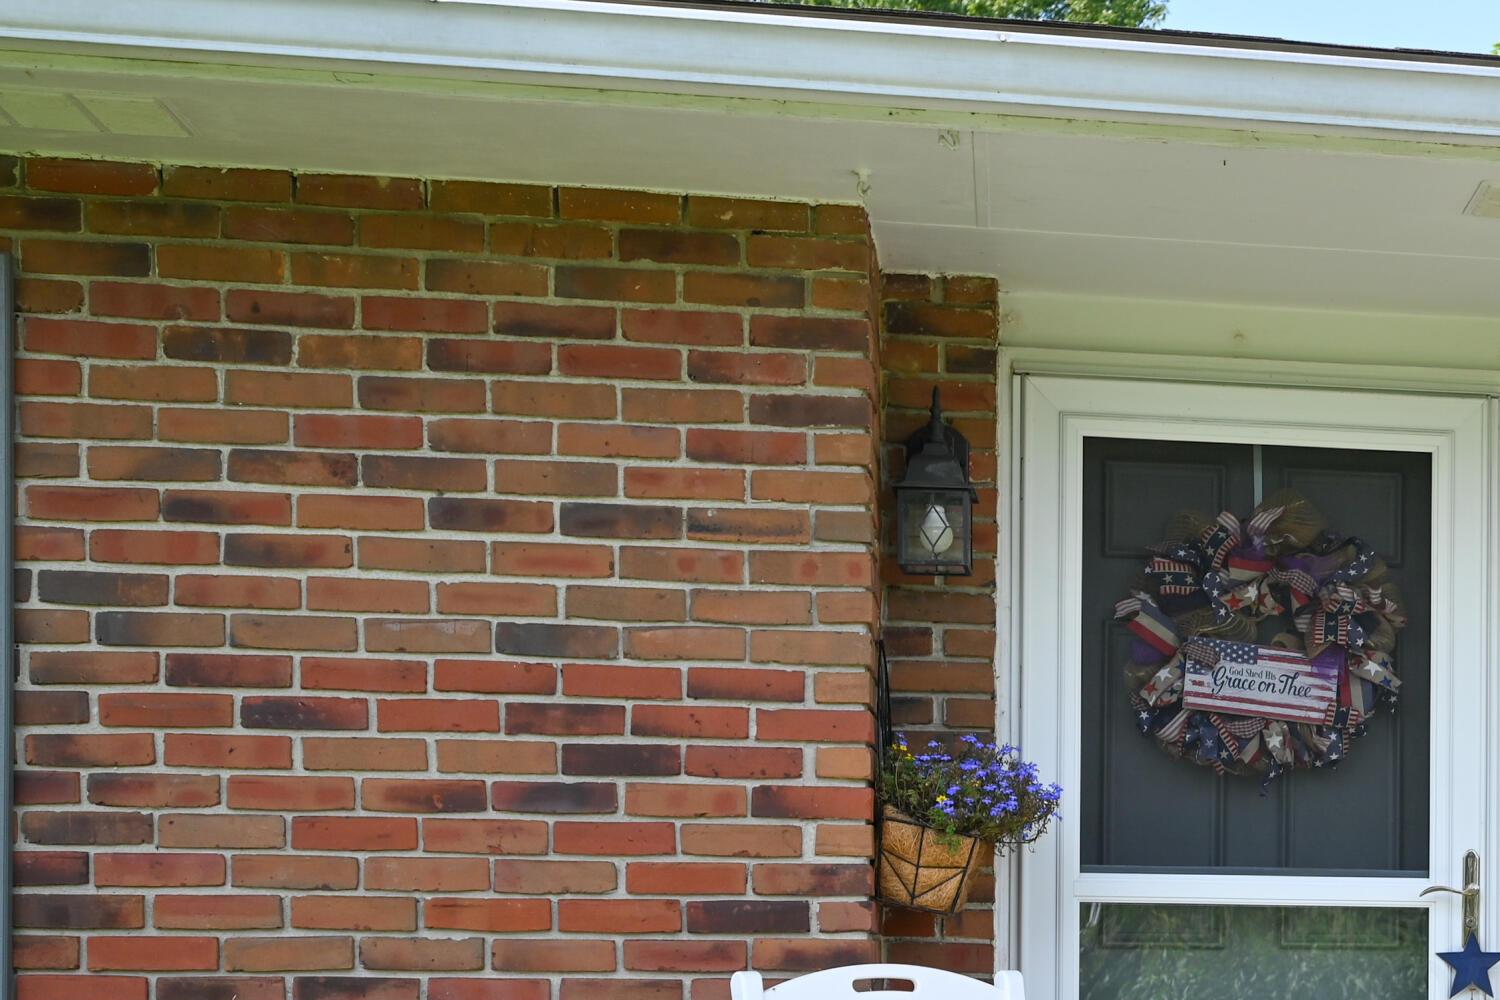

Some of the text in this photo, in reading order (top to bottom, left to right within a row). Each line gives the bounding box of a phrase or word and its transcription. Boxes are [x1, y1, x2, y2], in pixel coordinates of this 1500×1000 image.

[1211, 665, 1312, 698] Grace on Thee
[1229, 666, 1277, 681] God Shed His
